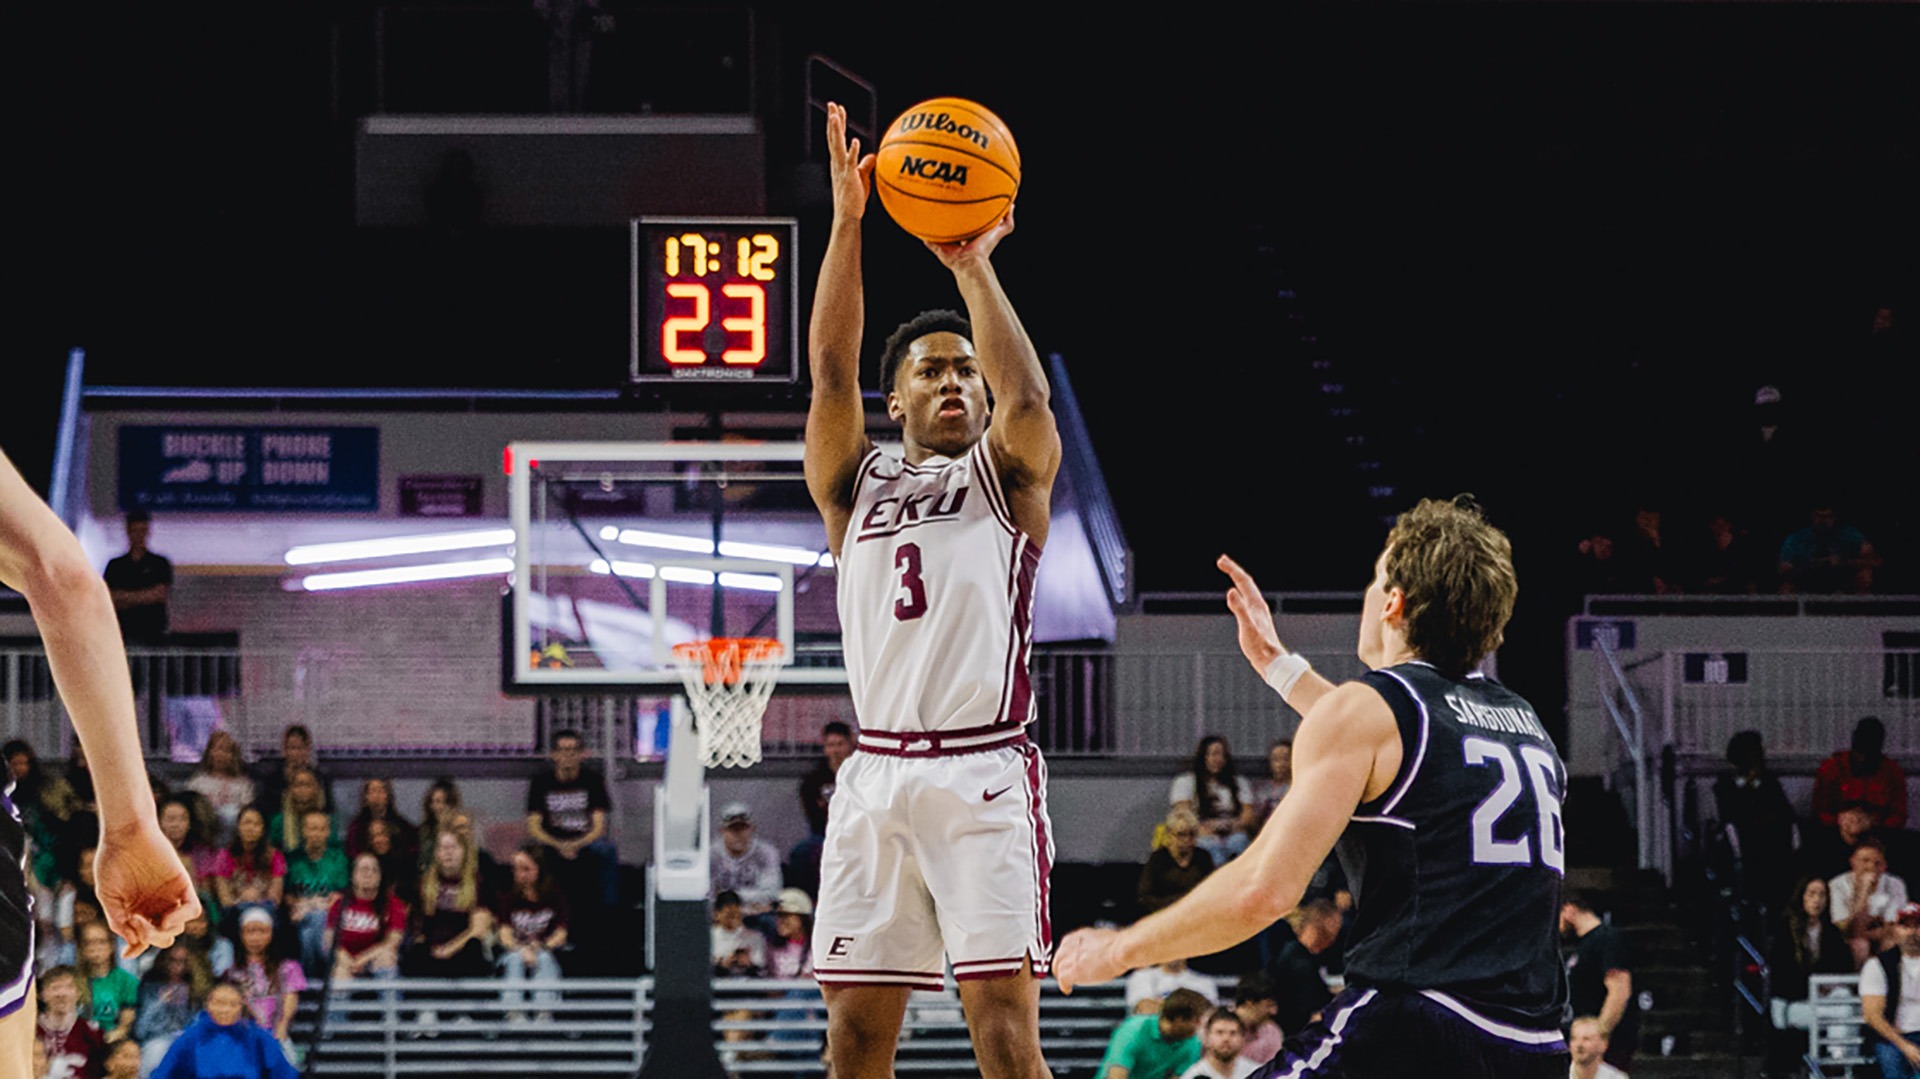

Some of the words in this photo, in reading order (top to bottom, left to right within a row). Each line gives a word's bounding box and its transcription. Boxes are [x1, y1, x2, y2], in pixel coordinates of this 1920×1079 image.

[900, 113, 989, 149] Wilson
[900, 155, 967, 186] NCAA
[662, 283, 766, 364] 23
[861, 486, 970, 531] EKU
[894, 542, 928, 622] 3
[1462, 736, 1565, 878] 26
[828, 935, 855, 957] E
